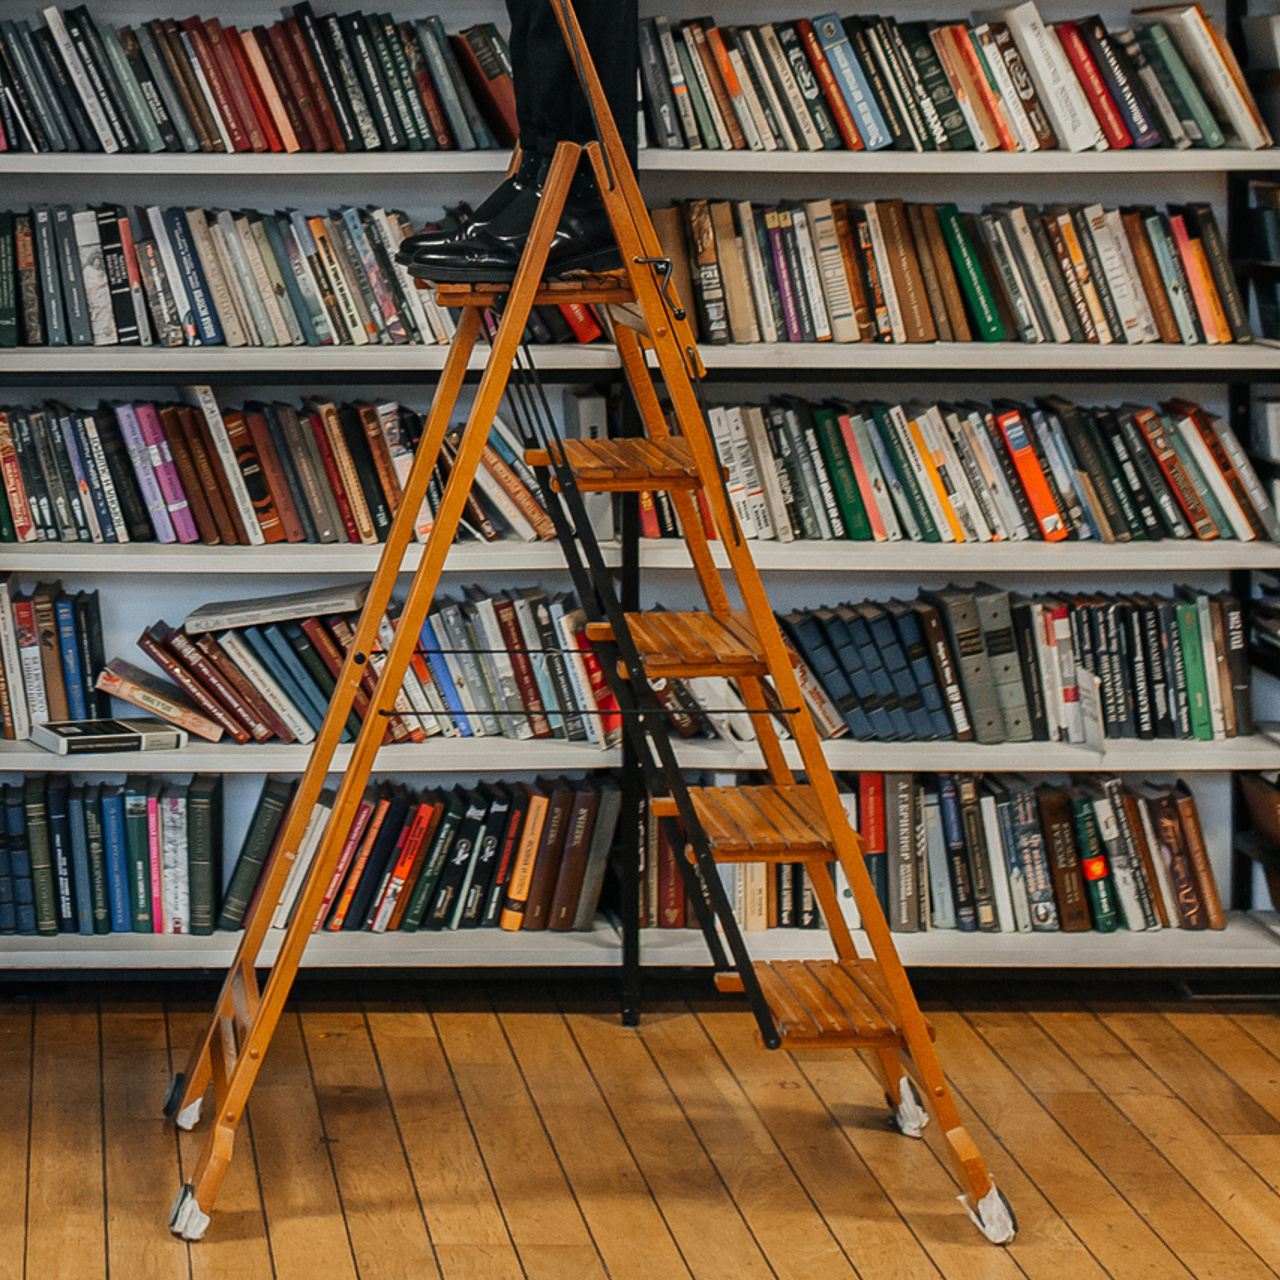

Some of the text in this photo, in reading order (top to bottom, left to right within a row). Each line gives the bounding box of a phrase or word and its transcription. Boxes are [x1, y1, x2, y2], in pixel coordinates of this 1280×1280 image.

[191, 288, 216, 339] НОВАЯ ИСТОРИЯ
[3, 462, 27, 525] История России
[836, 467, 856, 504] ТРОЦКИЙ
[1100, 654, 1115, 704] КАРАМЗИН
[1110, 654, 1125, 704] КАРАМЗИН
[1147, 630, 1161, 680] КАРАМЗИН
[1169, 638, 1185, 689] КАРАМЗИН
[1134, 662, 1148, 712] КАРАМЗИН
[1050, 823, 1066, 869] РУССКАЯ
[1060, 821, 1076, 868] ИСТОРИЯ
